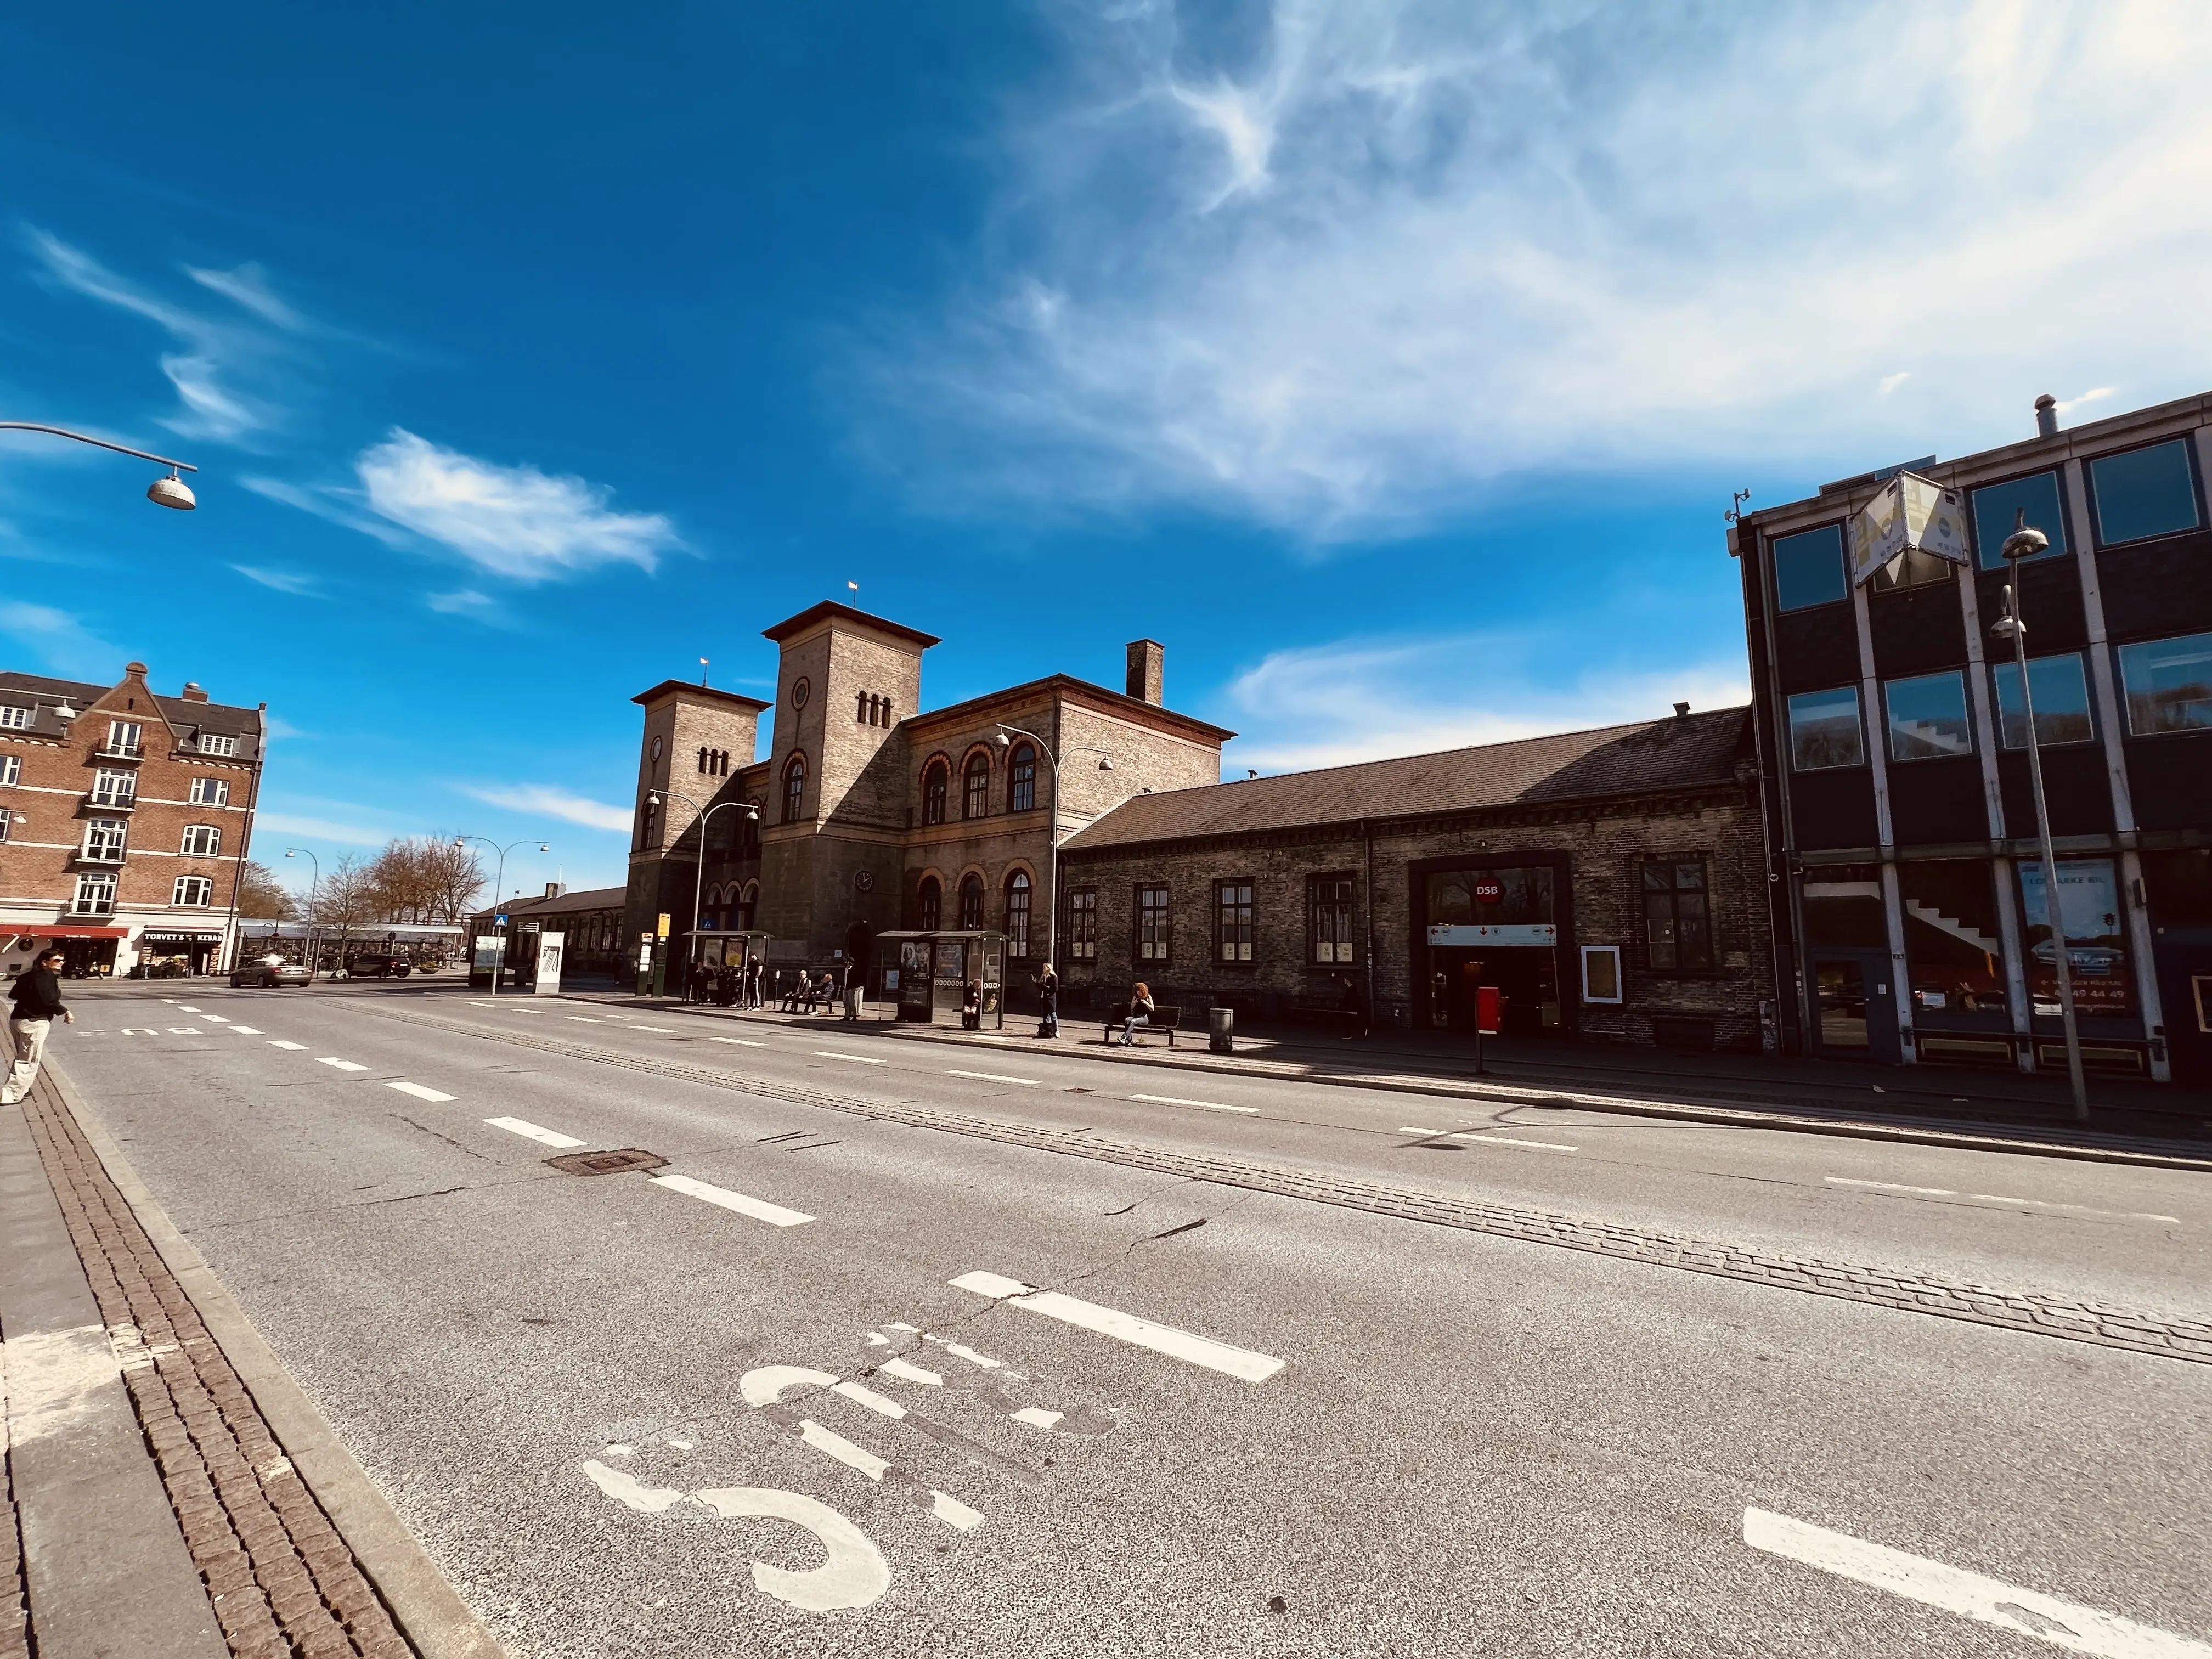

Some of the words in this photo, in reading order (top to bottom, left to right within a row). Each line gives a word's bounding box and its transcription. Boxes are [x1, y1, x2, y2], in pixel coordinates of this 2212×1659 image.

[1477, 885, 1498, 895] DSB
[2073, 990, 2086, 998] 49
[2091, 990, 2106, 998] 44
[2109, 990, 2125, 998] 49
